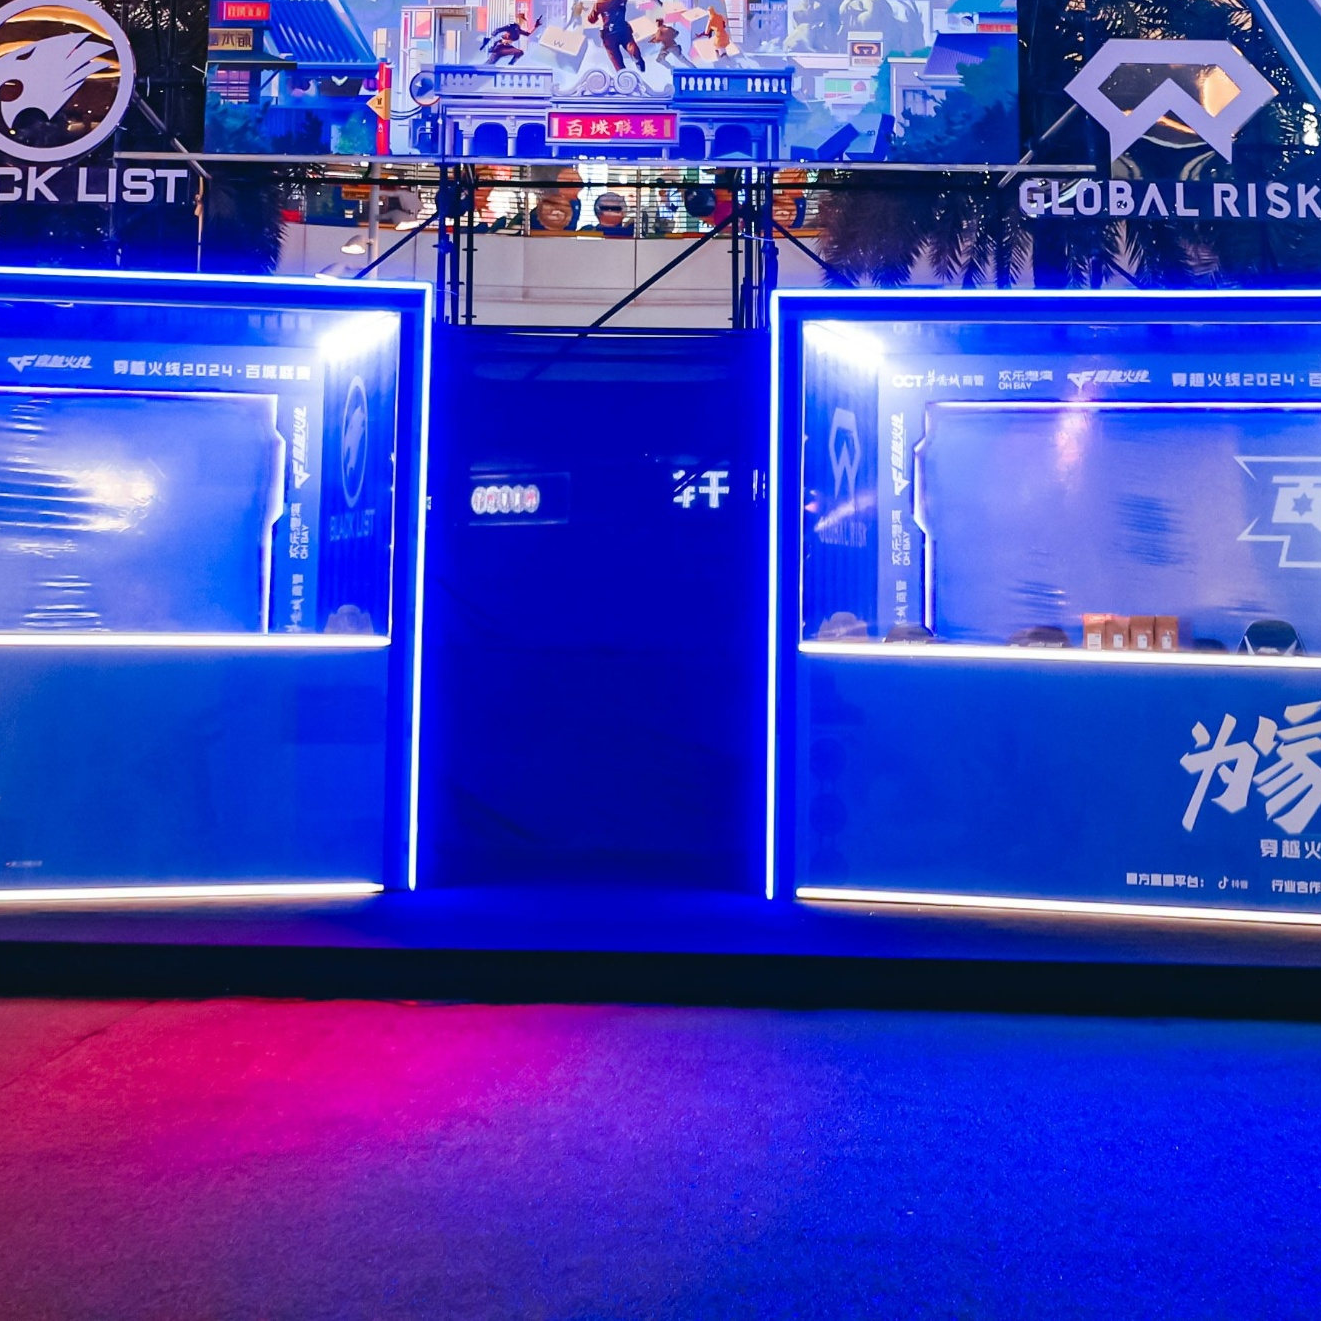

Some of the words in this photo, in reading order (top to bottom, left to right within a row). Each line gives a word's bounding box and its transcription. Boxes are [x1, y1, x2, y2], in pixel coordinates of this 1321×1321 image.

[566, 119, 659, 137] 百城联赛
[78, 167, 188, 203] LIST
[1019, 180, 1200, 217] GLOBAL
[891, 374, 923, 388] OCT
[997, 382, 1012, 390] OH
[1013, 382, 1032, 390] BAY
